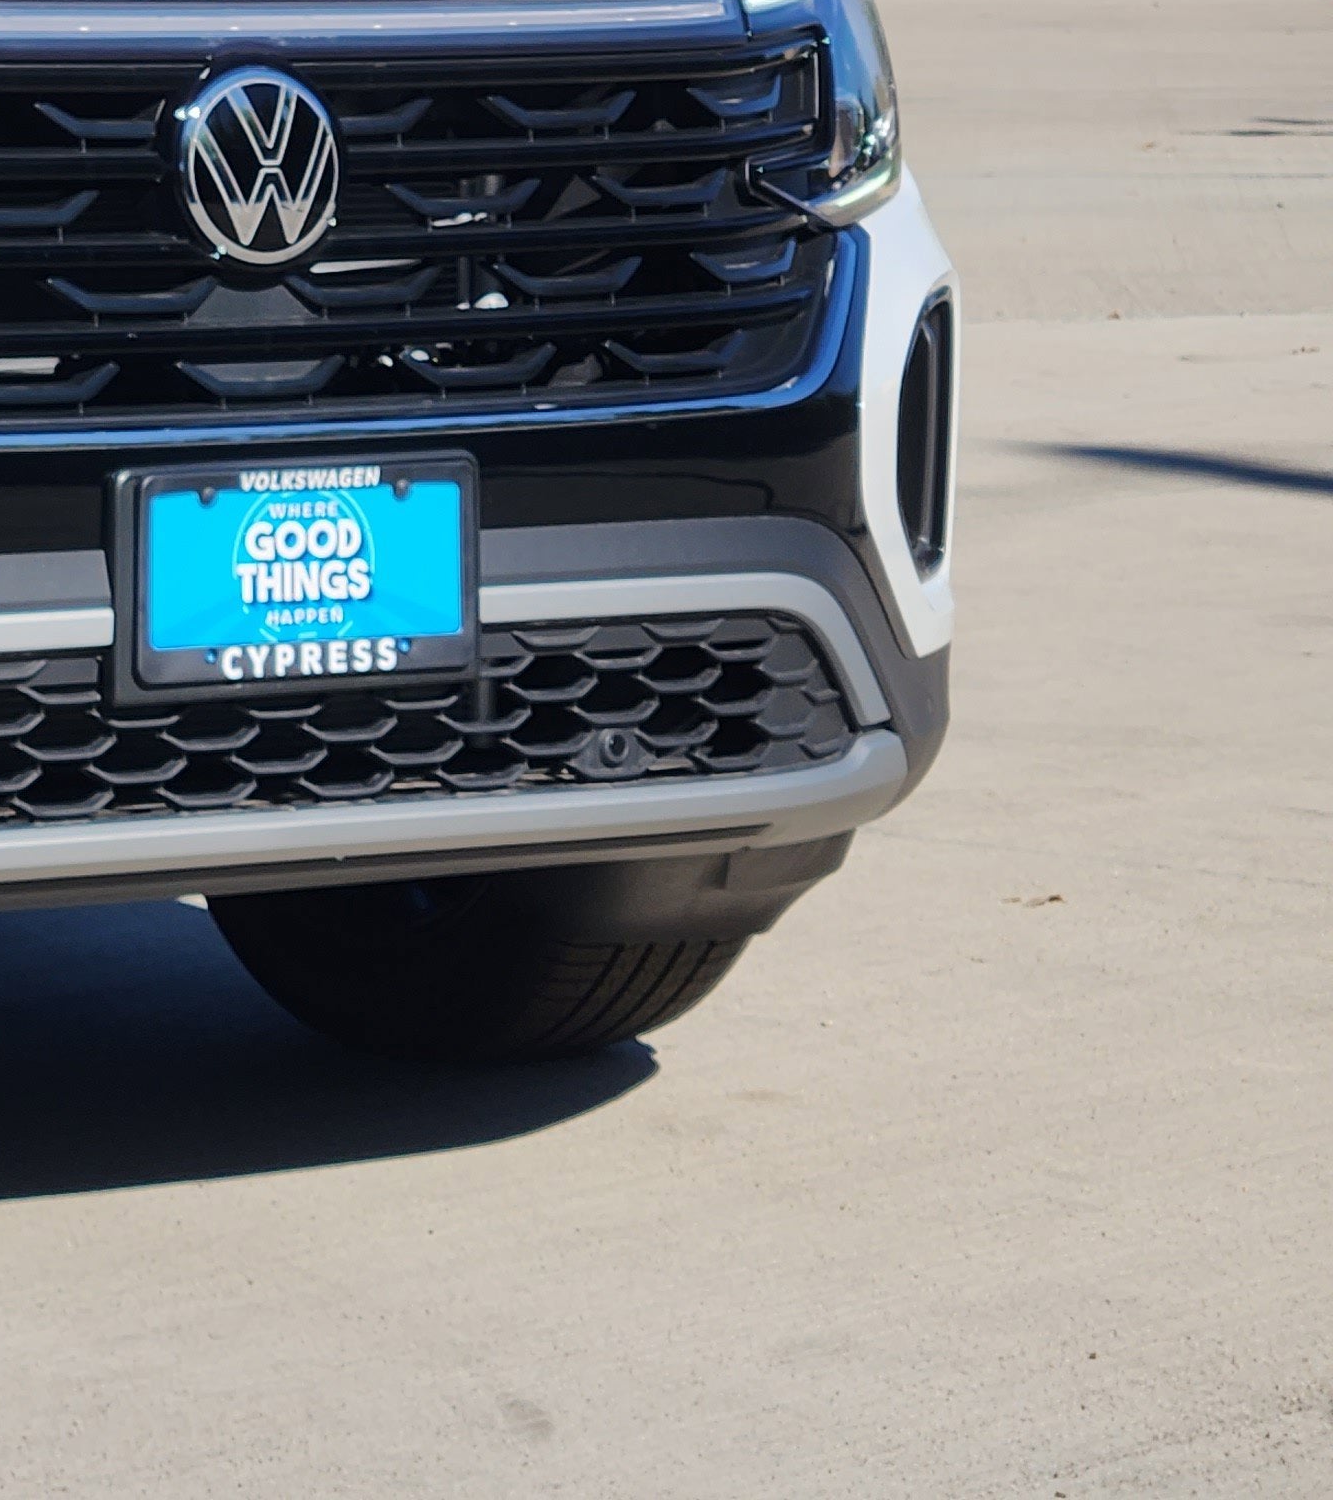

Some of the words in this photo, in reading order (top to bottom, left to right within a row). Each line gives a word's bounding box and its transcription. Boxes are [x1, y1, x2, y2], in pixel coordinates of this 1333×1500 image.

[189, 78, 335, 250] VW
[239, 466, 381, 492] VOLKSWAGEN
[268, 501, 339, 519] WHERE
[245, 519, 362, 561] GOOD
[237, 558, 371, 603] THINGS
[265, 605, 344, 627] HAPPEN
[221, 637, 398, 680] CYPRESS
